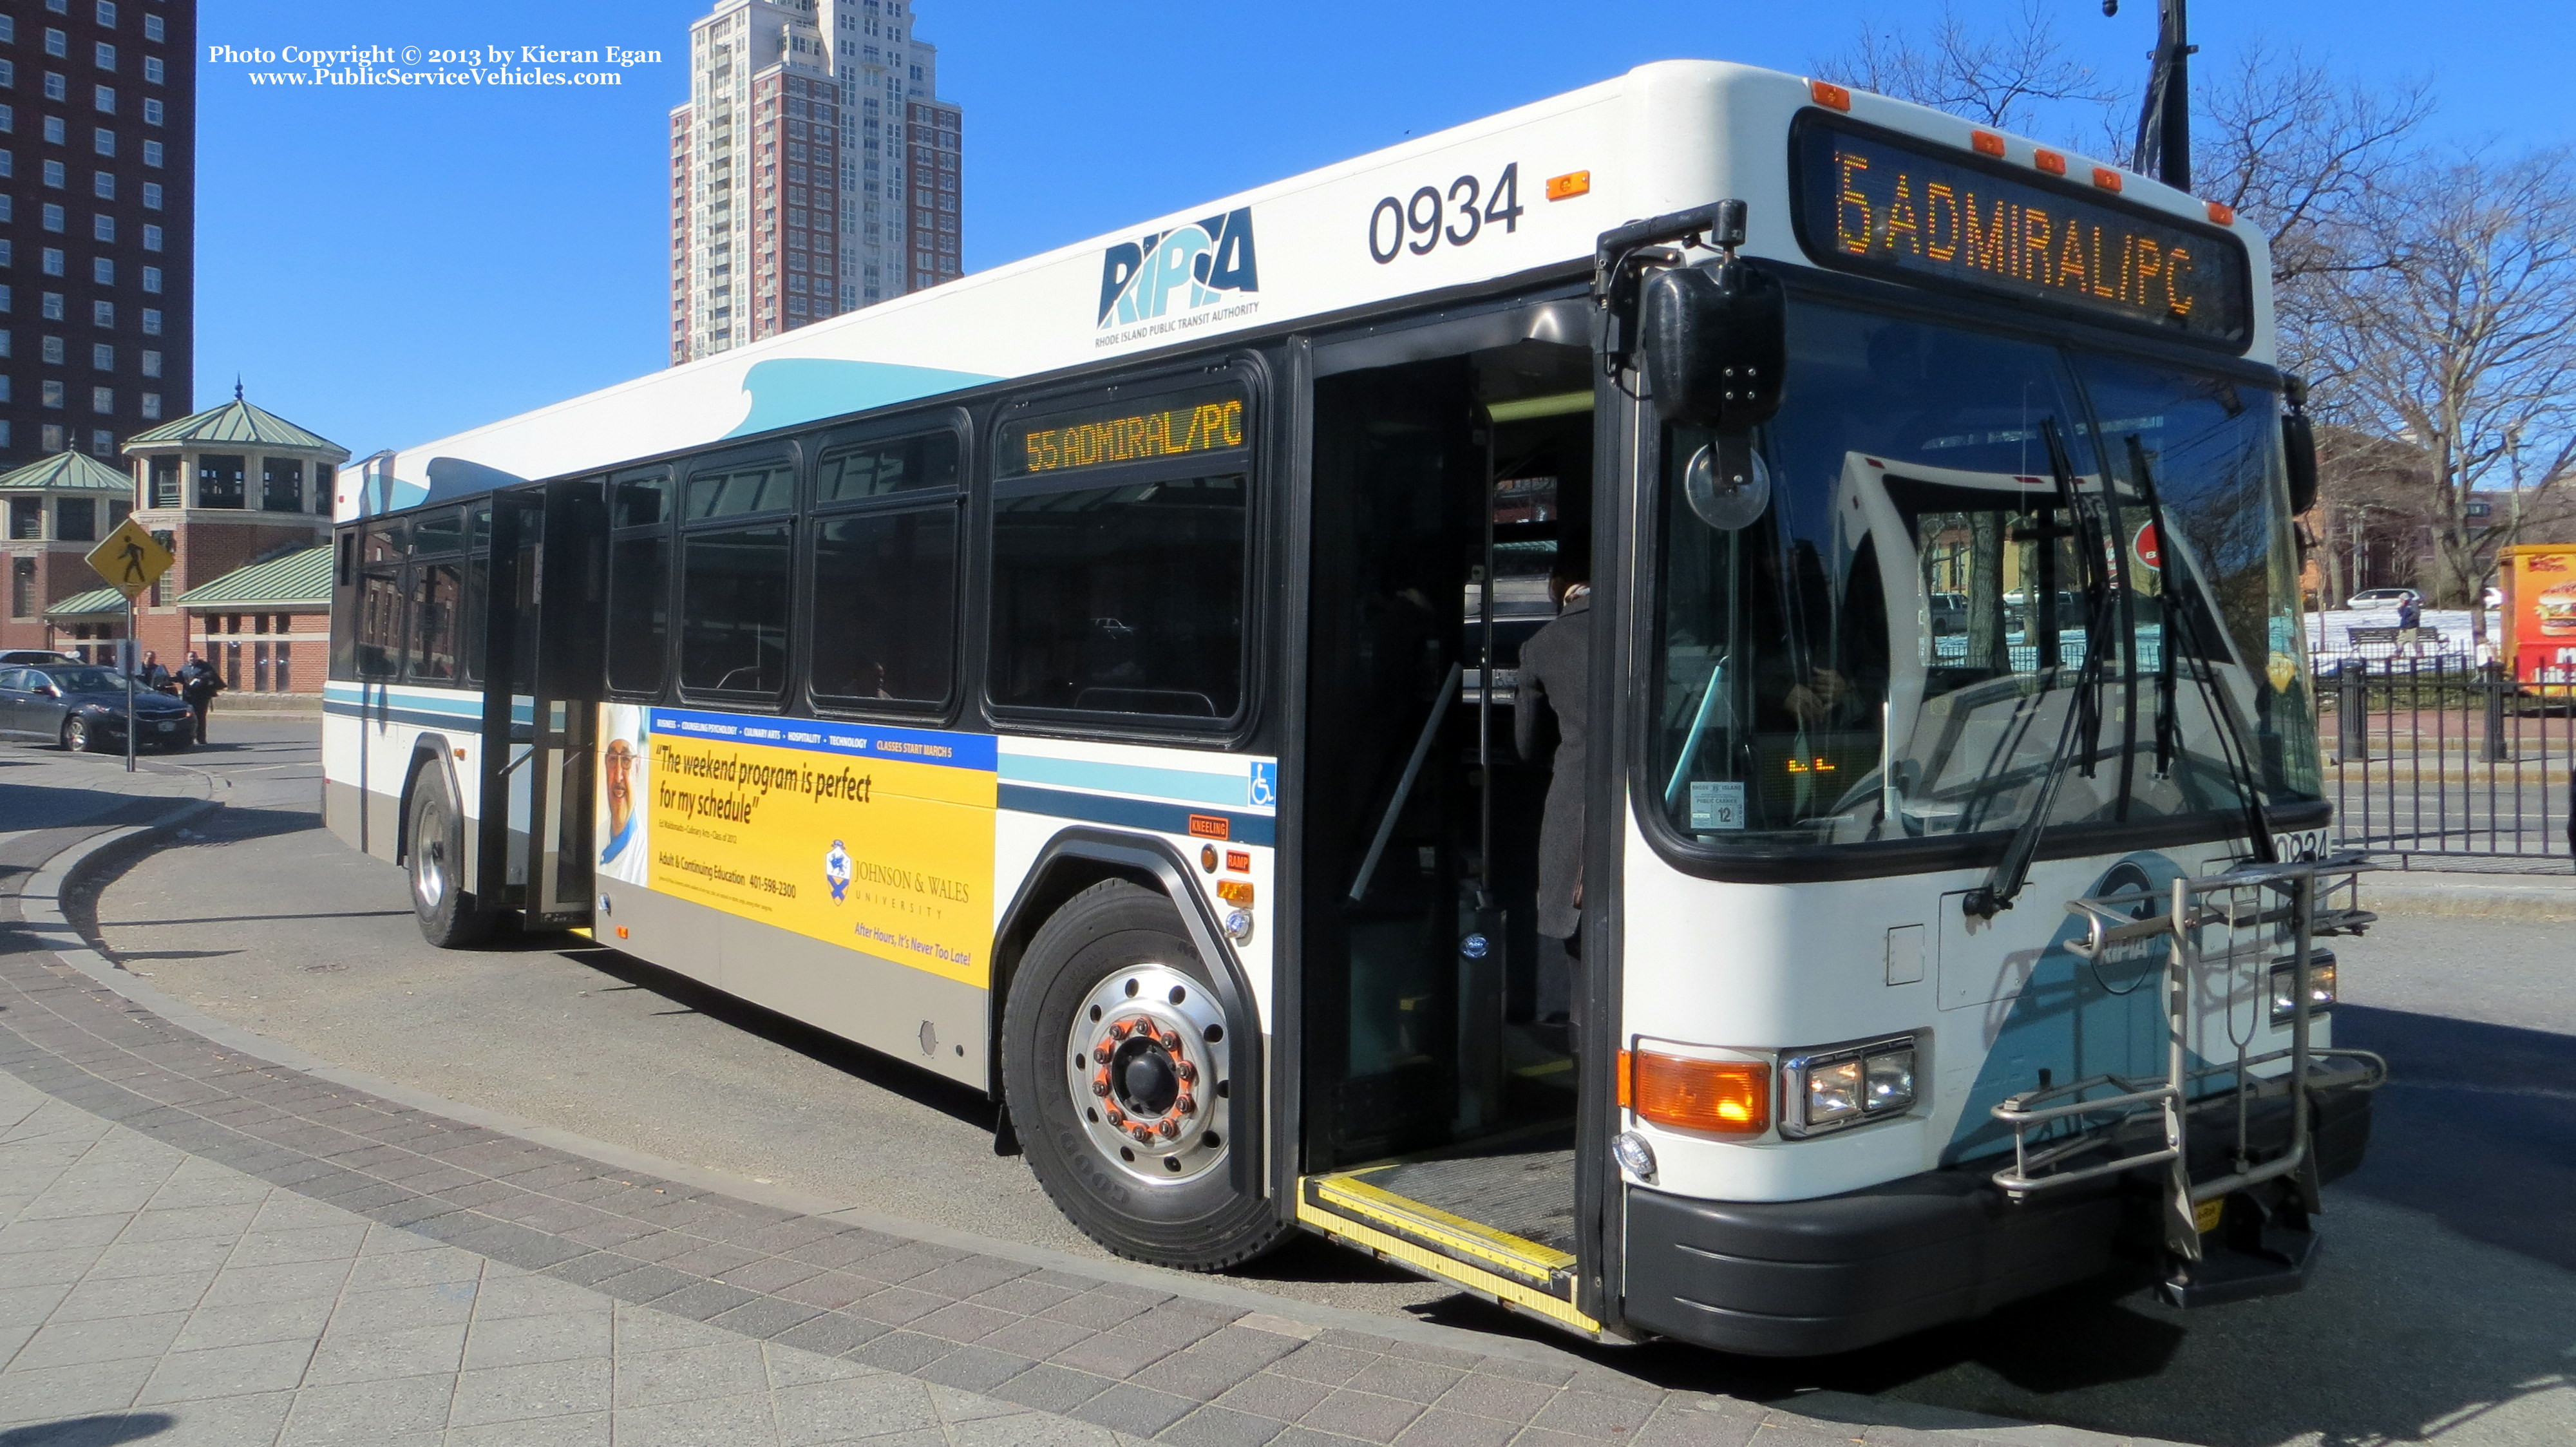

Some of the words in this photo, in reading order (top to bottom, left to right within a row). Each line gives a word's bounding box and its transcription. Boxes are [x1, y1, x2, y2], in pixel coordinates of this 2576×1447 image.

[1369, 162, 1524, 264] 0934
[1887, 174, 2192, 314] ADMIRAL/PC
[1097, 206, 1259, 330] RIPTA
[1095, 334, 1119, 348] RHODE
[1121, 327, 1148, 343] ISLAND
[1150, 320, 1176, 336] PUBLIC
[1178, 312, 1210, 330] TRANSIT
[1211, 301, 1260, 322] AUTHORITY
[1027, 430, 1058, 471] 55
[1063, 400, 1242, 467] ADMIRAL/PC
[657, 719, 676, 729] BUSINESS
[681, 721, 708, 733] COUNSELING
[708, 723, 738, 735] PSYCHOLOGY
[743, 727, 767, 739] CULINARY
[767, 729, 781, 740] ARTS
[788, 731, 821, 744] HOSPITALITY
[829, 735, 867, 749] TECHNOLOGY
[876, 740, 902, 753] CLASSES
[903, 742, 923, 755] START
[923, 744, 947, 757] MARCH
[947, 746, 952, 758] 5
[684, 749, 737, 782] weekend
[737, 762, 798, 795] program
[800, 762, 813, 794] is
[814, 766, 871, 804] perfect
[659, 779, 676, 809] for
[677, 790, 696, 820] my
[1718, 807, 1731, 822] 12
[1191, 819, 1226, 835] KNEELING
[659, 851, 674, 867] Adult
[675, 855, 680, 868] &
[681, 856, 713, 881] Continuing
[714, 864, 745, 885] Education
[750, 874, 796, 899] 401-598-2300
[855, 860, 911, 890] JOHNSON
[914, 872, 925, 894] &
[928, 876, 969, 903] WALES
[1227, 855, 1248, 869] RAMP
[856, 890, 942, 920] UNIVERSITY
[855, 922, 873, 938] After
[873, 926, 896, 948] Hours,
[898, 934, 910, 949] It’s
[911, 937, 933, 956] Never
[934, 943, 949, 960] Too
[950, 947, 971, 967] Late!
